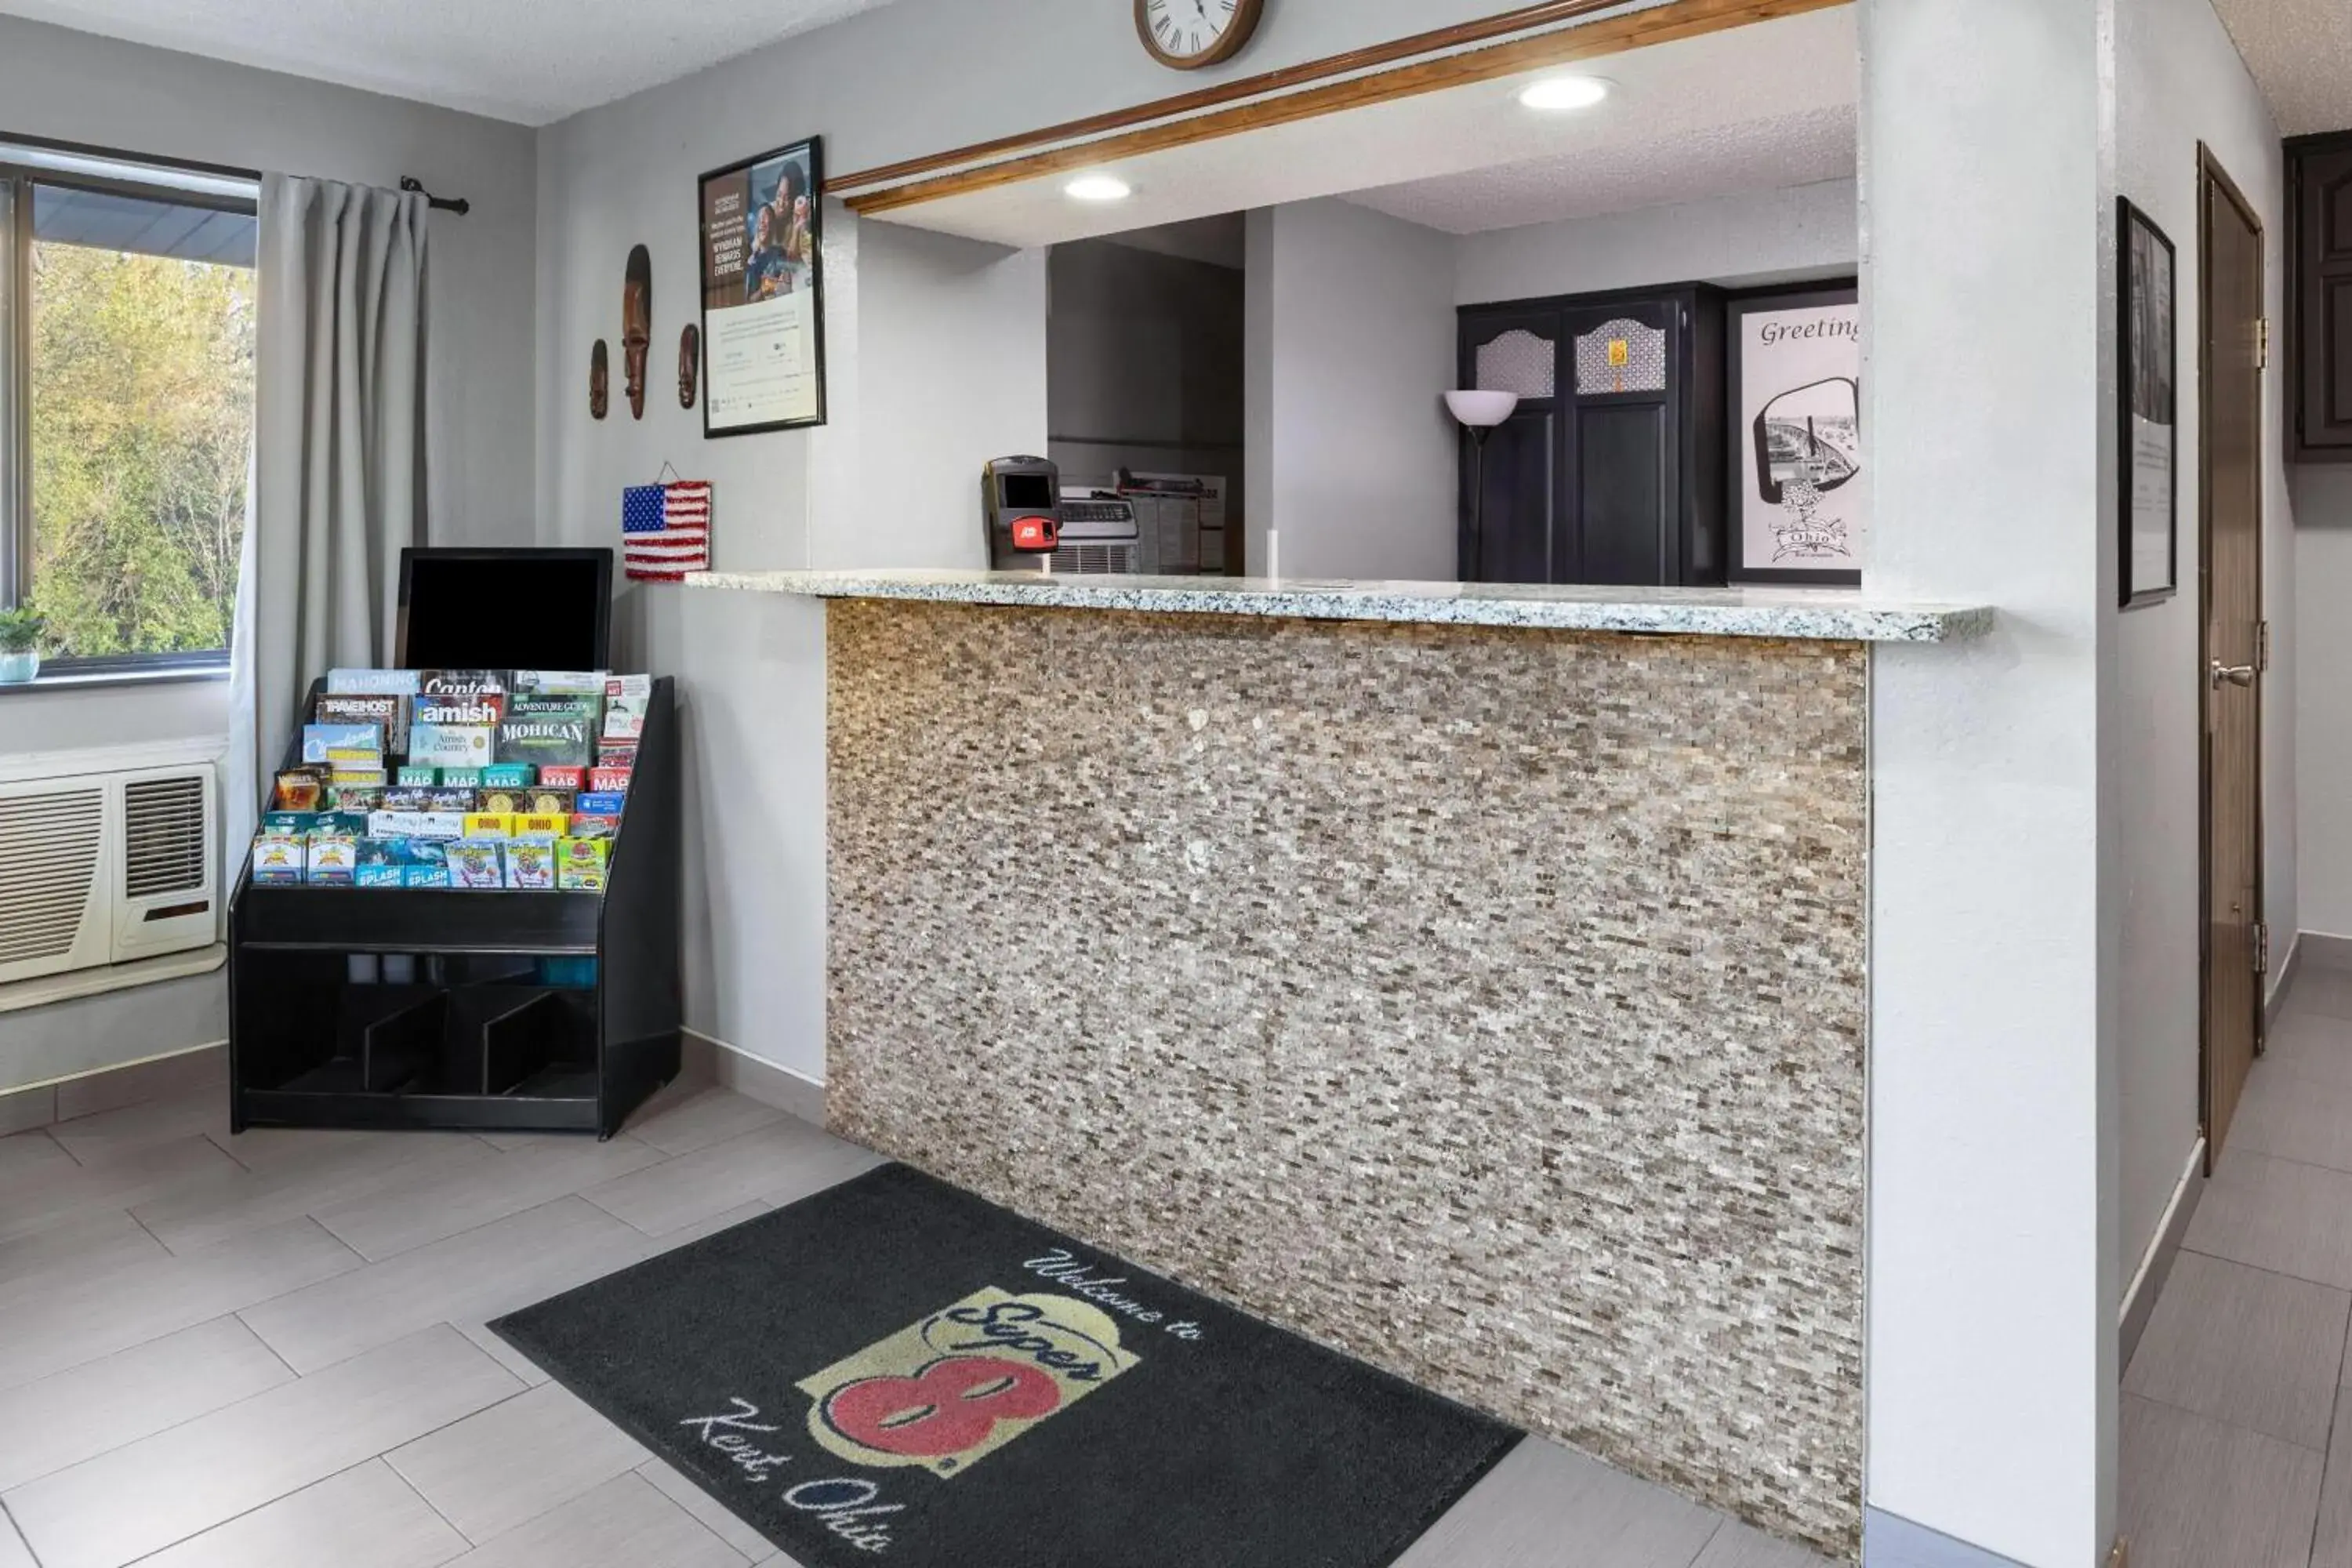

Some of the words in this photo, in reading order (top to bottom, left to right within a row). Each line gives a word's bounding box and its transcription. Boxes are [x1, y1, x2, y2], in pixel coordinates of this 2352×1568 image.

[334, 672, 416, 690] MAHONING
[325, 699, 394, 713] TRAVELHOST
[423, 702, 497, 722] amish
[514, 701, 564, 713] ADVENTURE
[500, 723, 584, 743] MOHICAN
[399, 775, 432, 786] MAP
[444, 776, 479, 787] MAP
[485, 778, 521, 787] MAP
[543, 777, 578, 786] MAP
[593, 776, 629, 791] MAP
[360, 869, 401, 886] SPLASH
[408, 869, 448, 886] SPLASH
[1023, 1248, 1163, 1323] Welcome
[1164, 1320, 1201, 1340] to
[946, 1301, 1102, 1381] Super
[782, 1477, 906, 1553] Ohio
